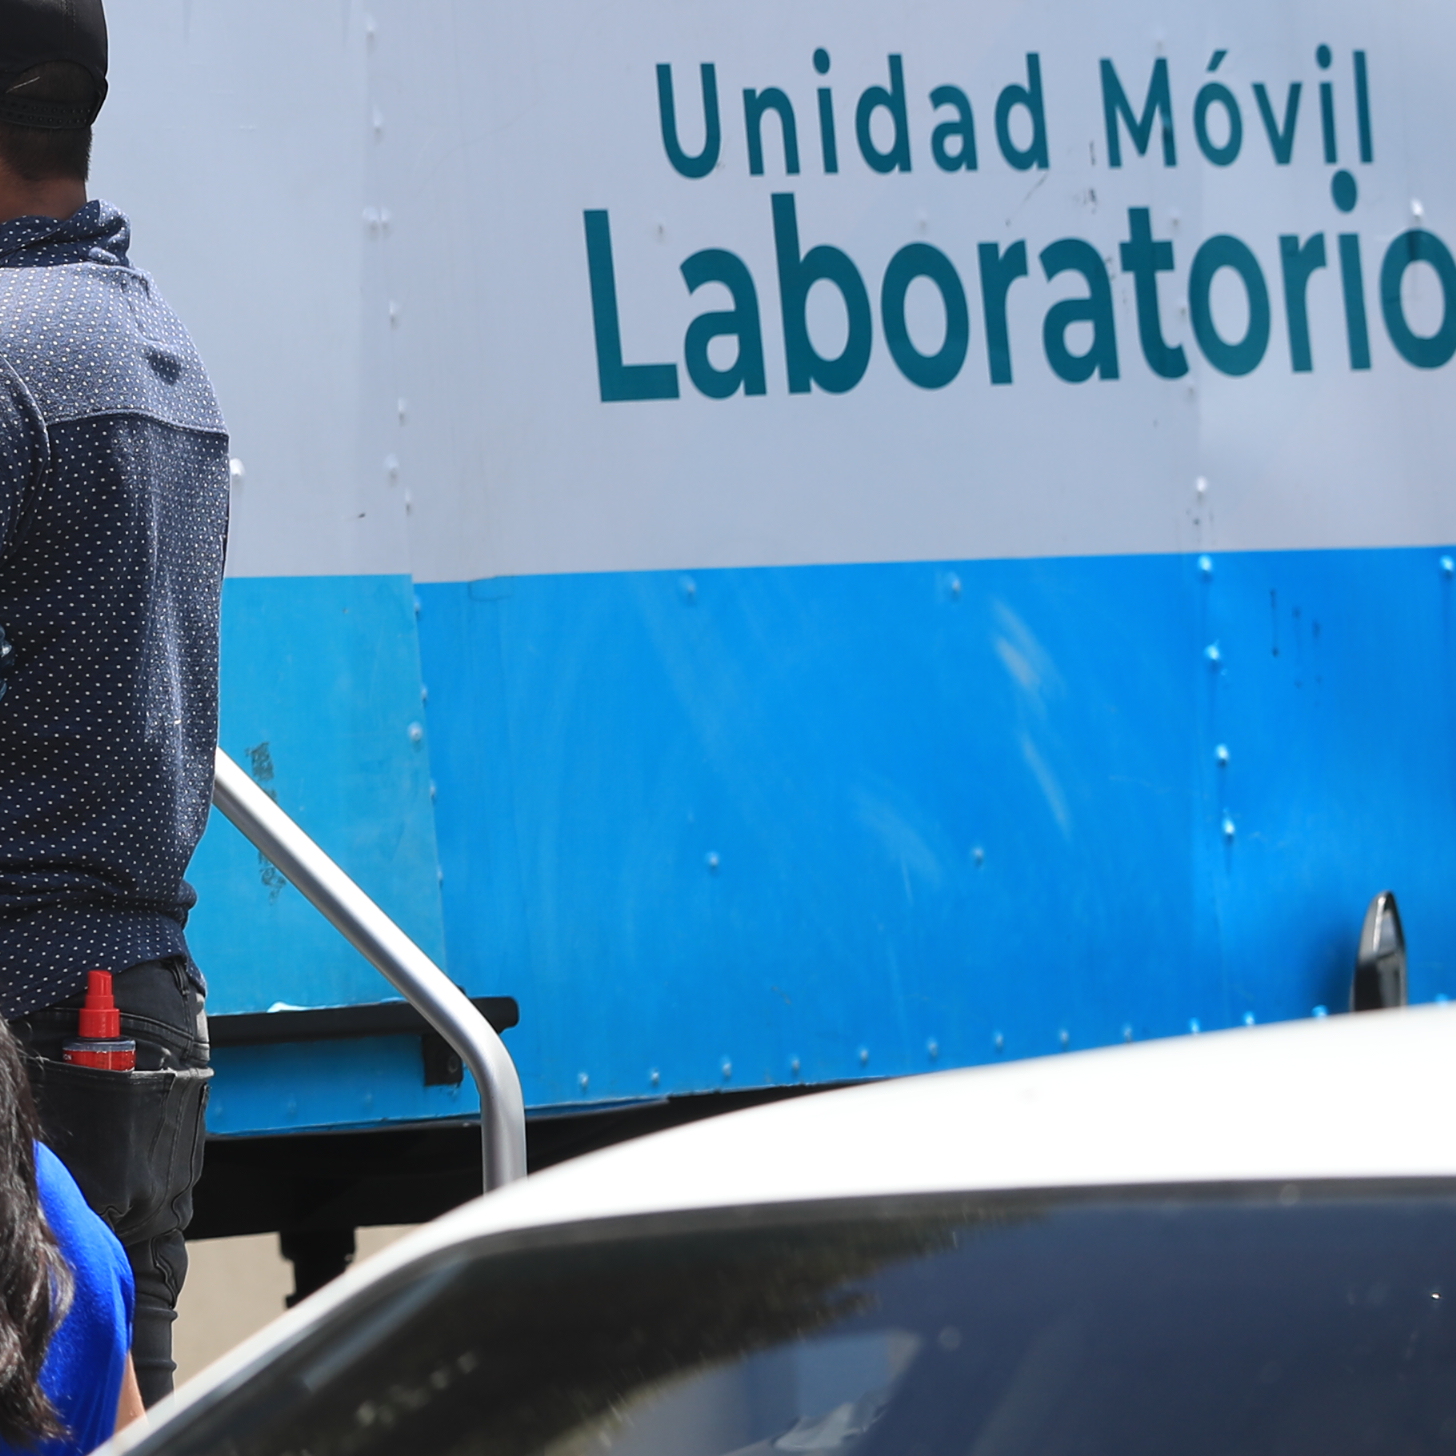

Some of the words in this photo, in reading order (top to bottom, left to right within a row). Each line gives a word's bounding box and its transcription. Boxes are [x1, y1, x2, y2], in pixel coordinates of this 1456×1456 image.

[656, 48, 1049, 179] Unidad
[1100, 44, 1374, 168] Móvil
[583, 170, 1456, 402] Laboratorio
